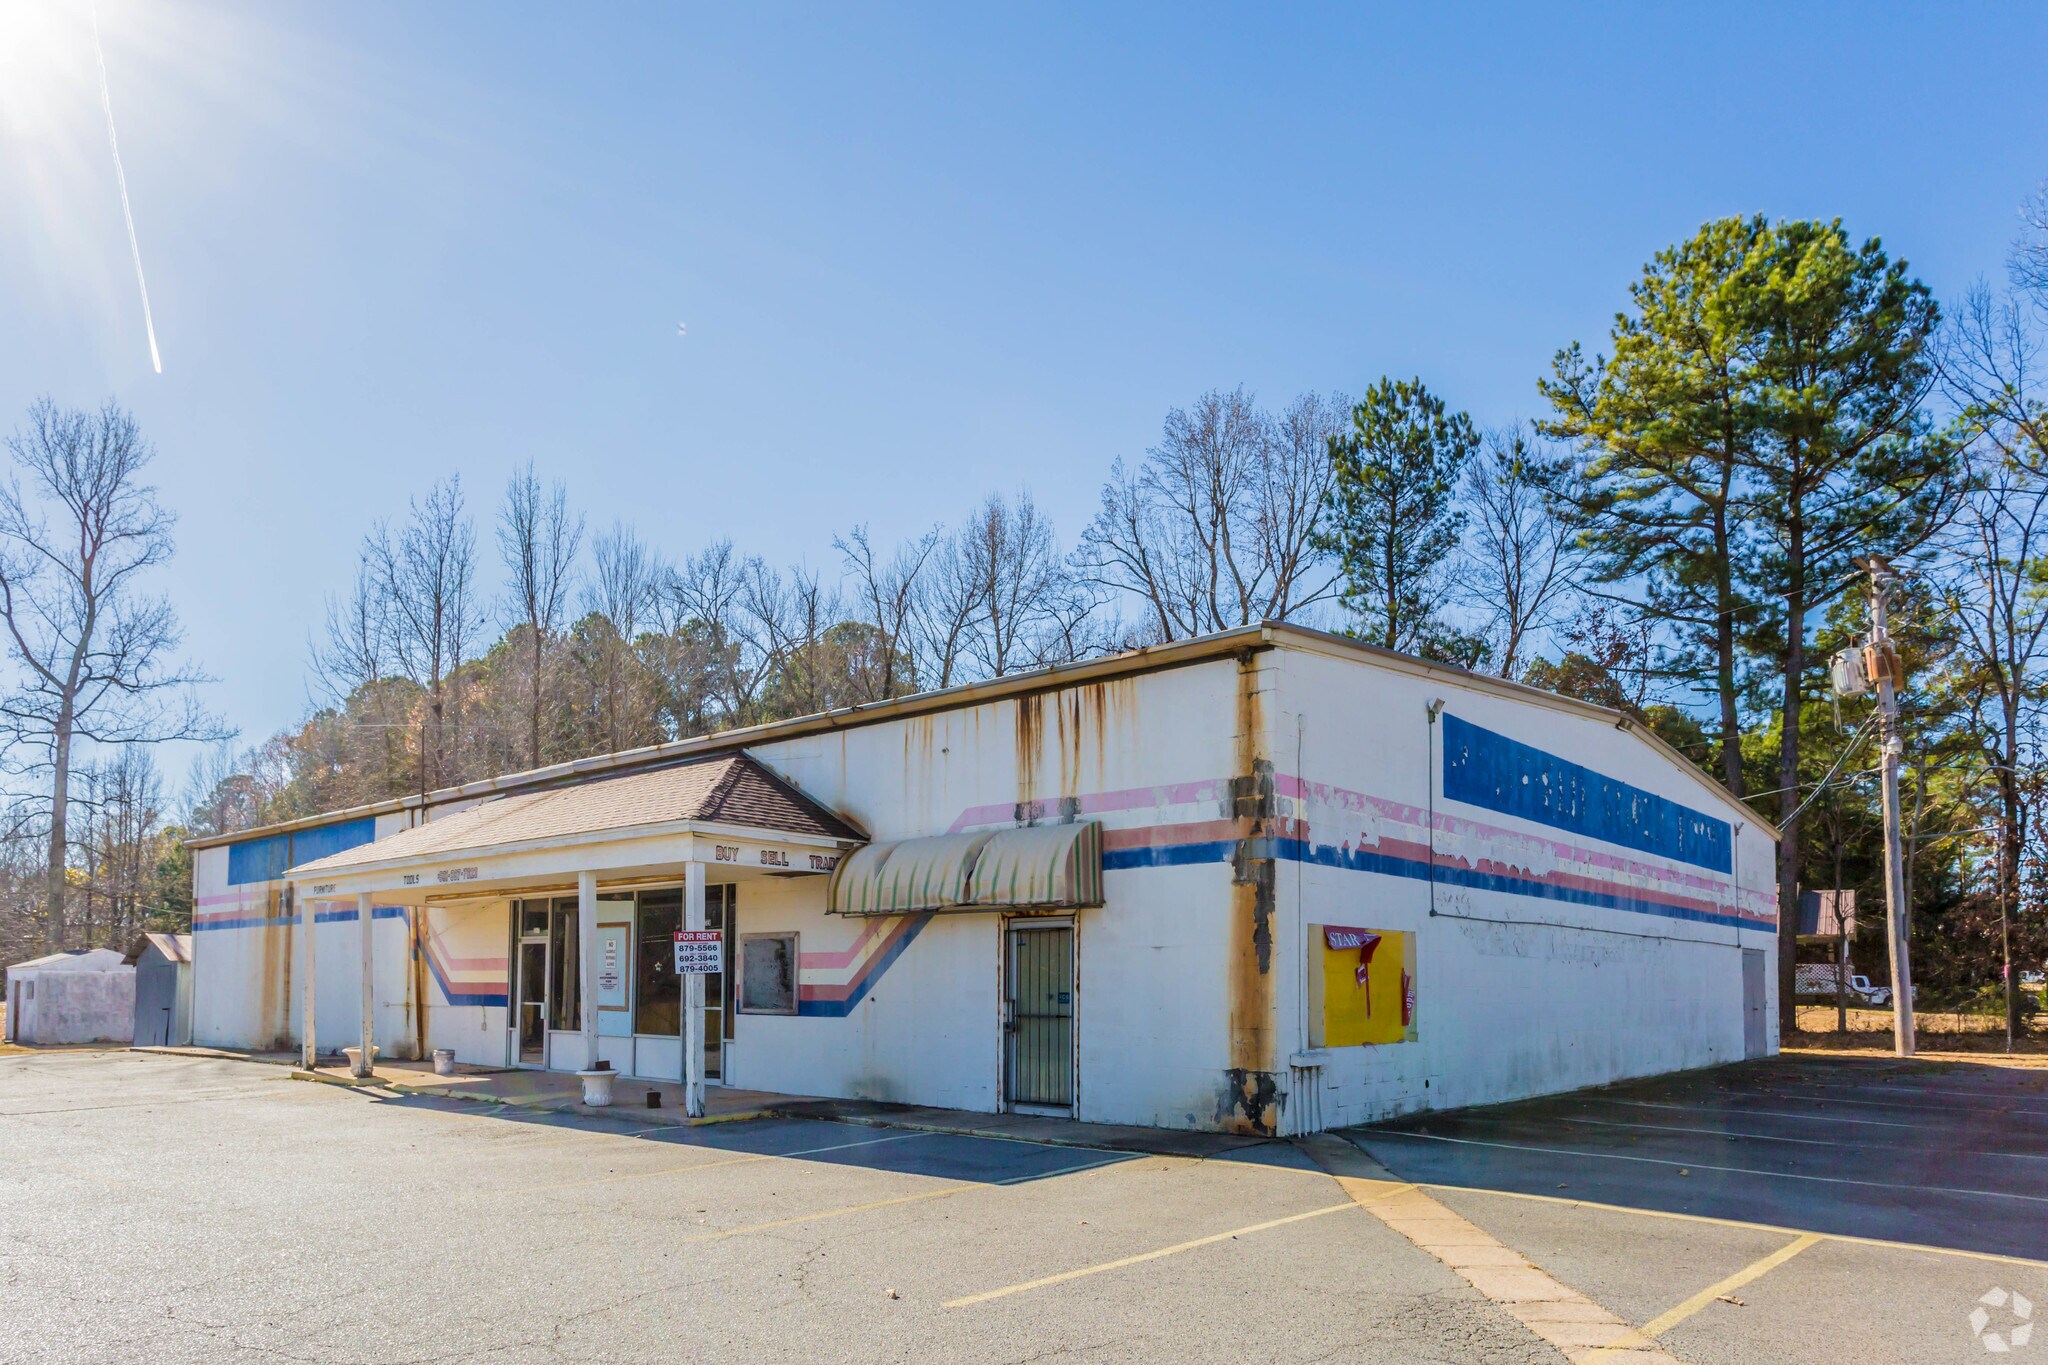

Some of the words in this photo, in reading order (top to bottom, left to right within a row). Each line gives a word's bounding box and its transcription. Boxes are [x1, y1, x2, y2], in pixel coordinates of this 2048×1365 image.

[715, 845, 740, 862] BUY
[760, 850, 790, 867] SELL
[403, 874, 420, 885] TOOLS
[1329, 932, 1361, 946] STAR
[678, 944, 718, 952] 879-5566
[678, 954, 718, 963] 692-3840
[679, 964, 719, 973] 879-4005
